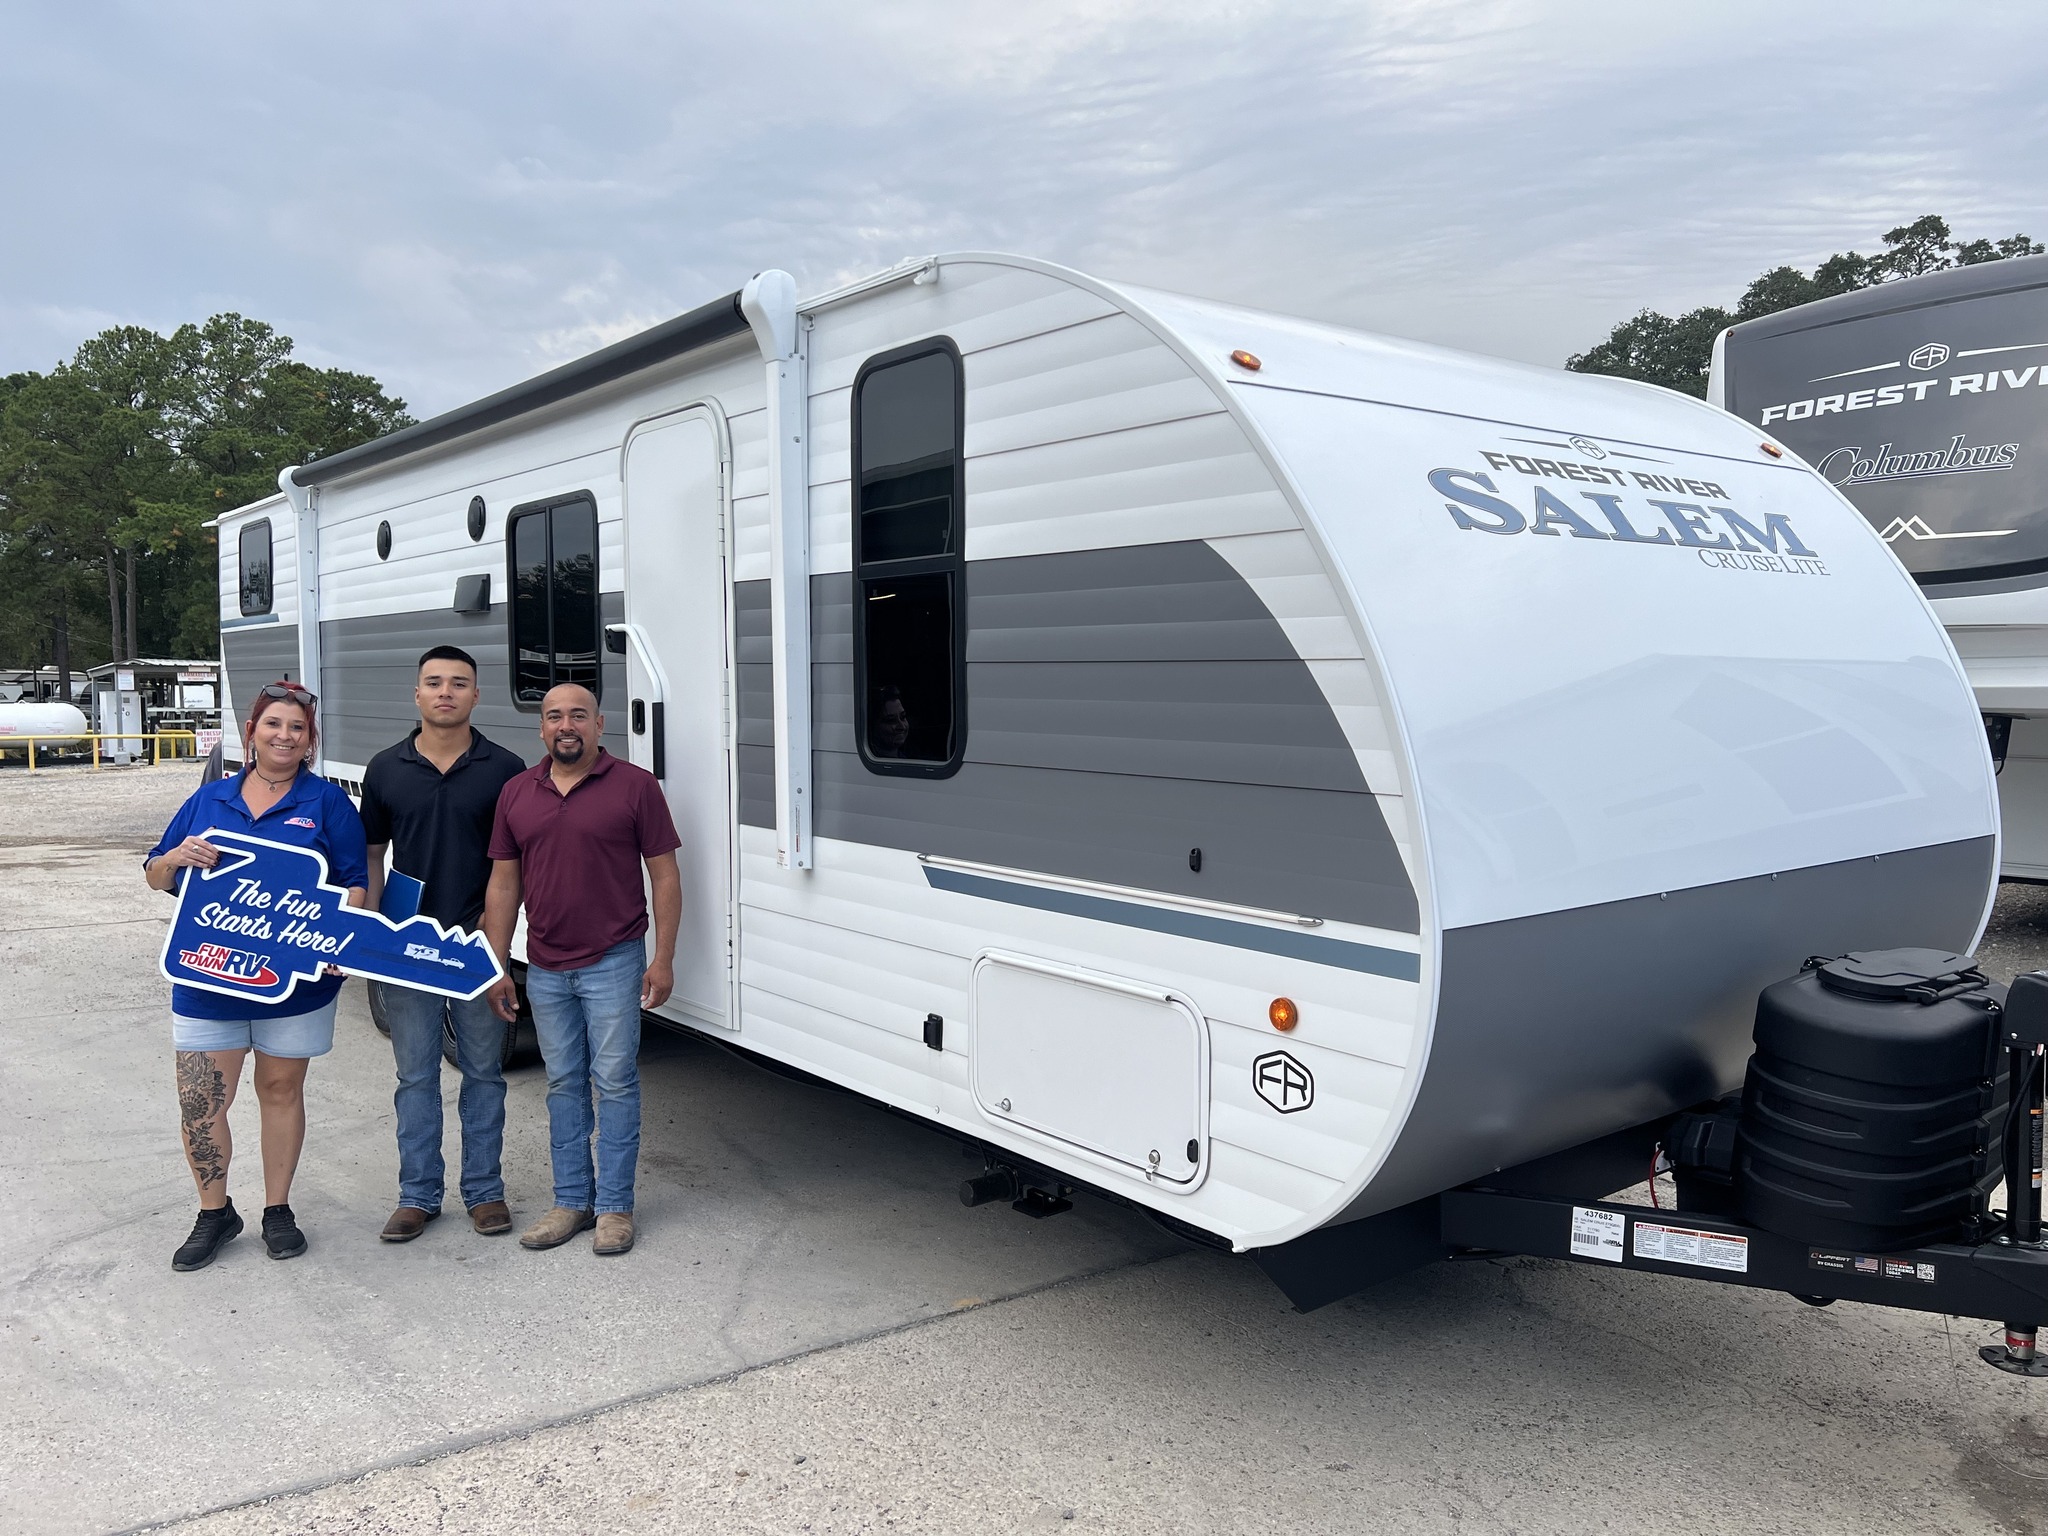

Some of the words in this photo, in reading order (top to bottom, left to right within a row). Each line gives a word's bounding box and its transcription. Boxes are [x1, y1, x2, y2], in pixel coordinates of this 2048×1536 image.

[1761, 379, 1938, 426] FOREST
[1478, 450, 1627, 487] FOREST
[1628, 471, 1732, 501] RIVER
[1816, 434, 2020, 488] Columbus
[1427, 467, 1819, 558] SALEM
[229, 877, 272, 909] The
[274, 888, 322, 921] Fun
[193, 902, 273, 940] Starts
[276, 919, 355, 956] Here!
[199, 943, 231, 960] FUN
[180, 950, 226, 971] TOWN
[221, 949, 269, 978] RV
[1584, 1210, 1613, 1221] 437682
